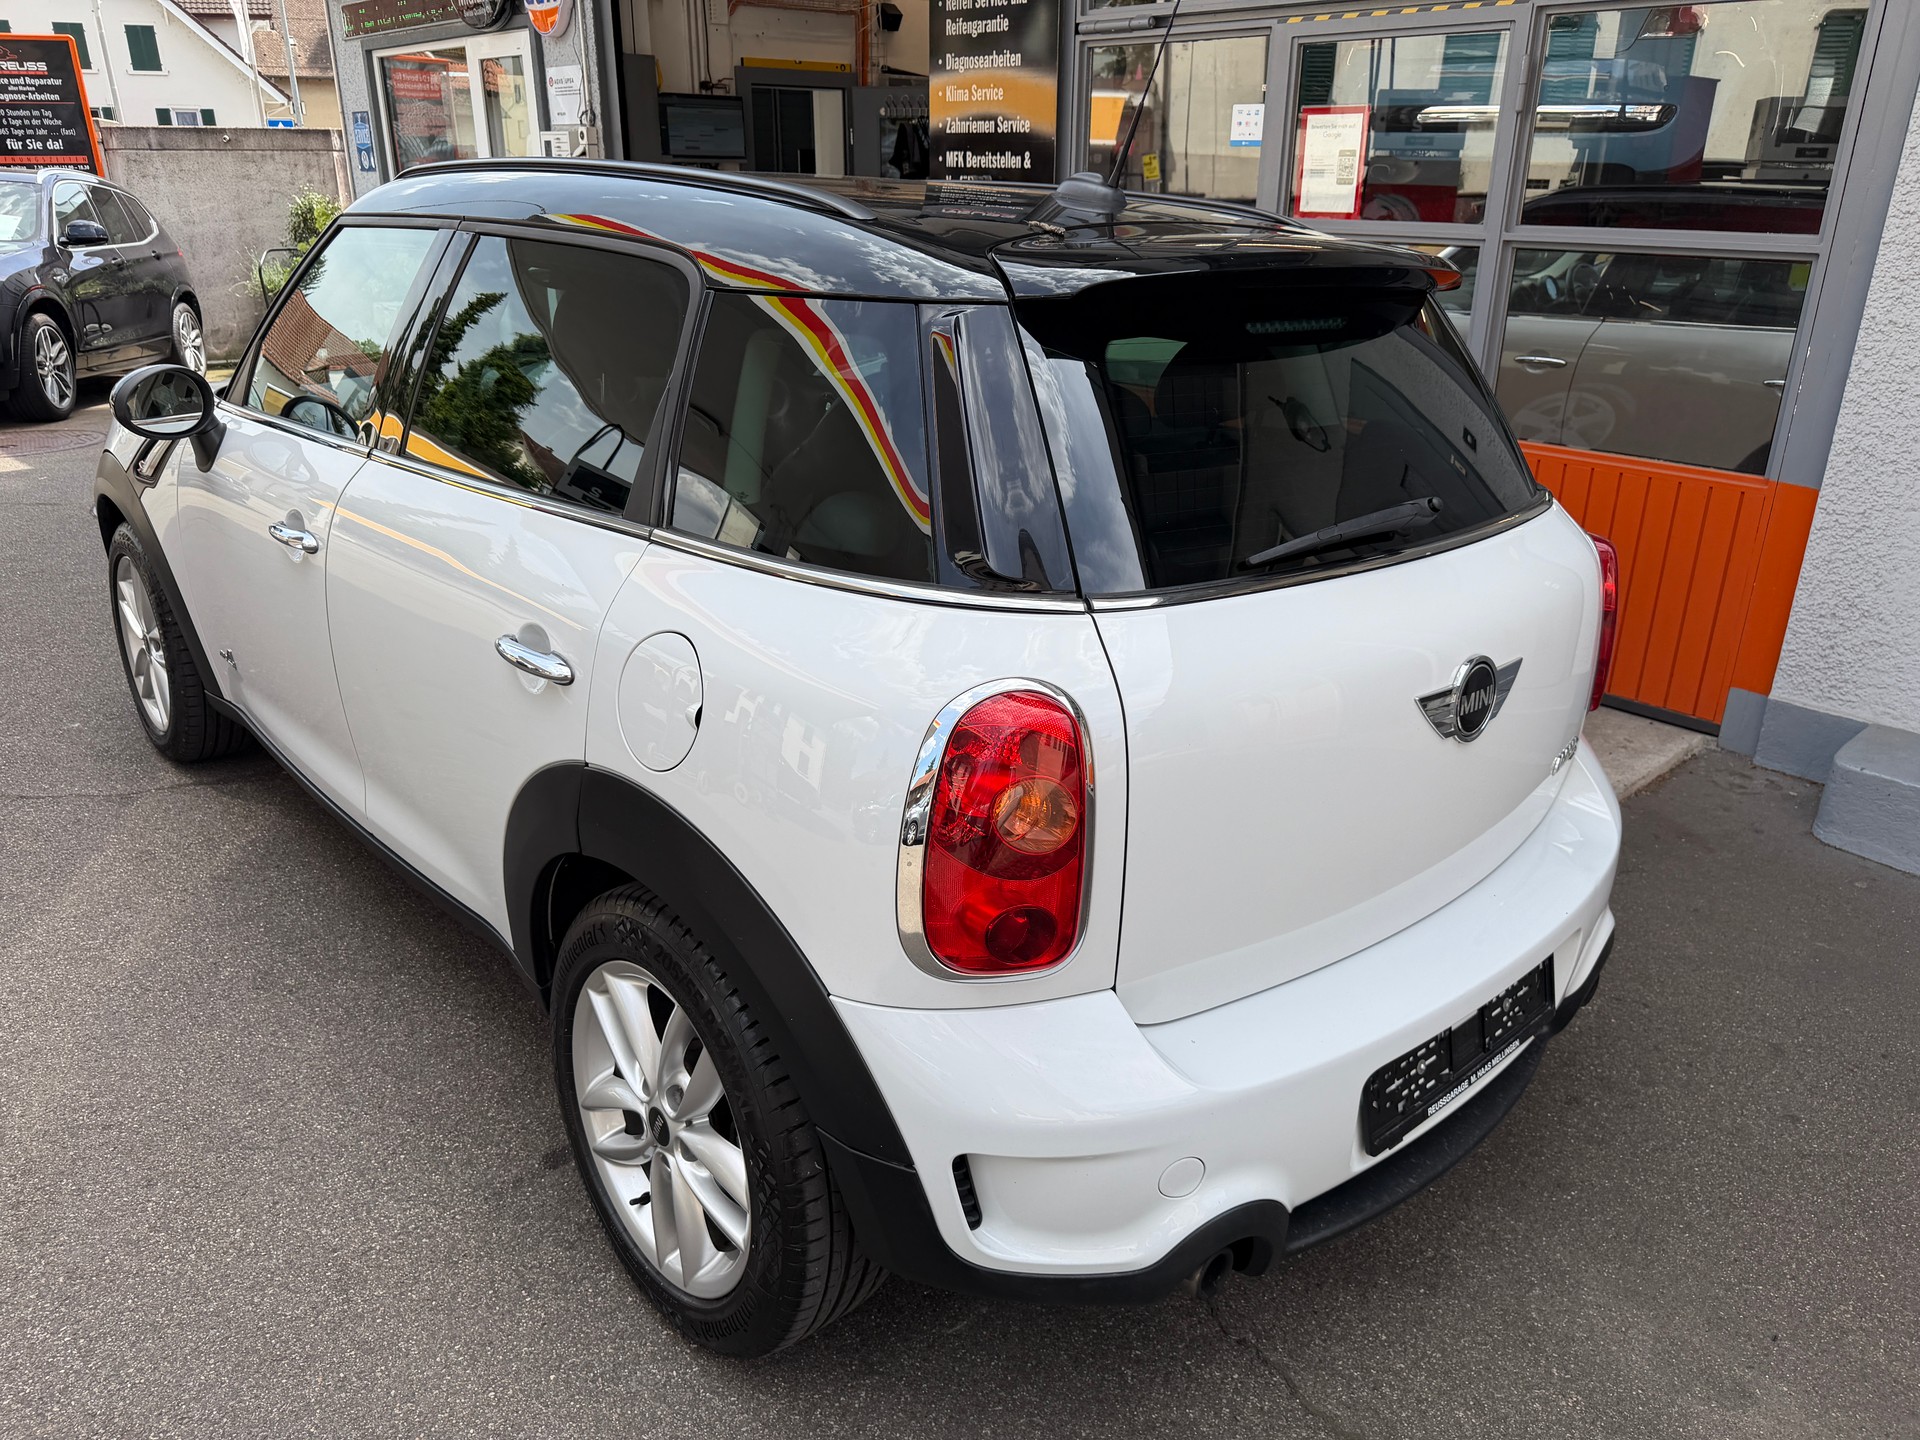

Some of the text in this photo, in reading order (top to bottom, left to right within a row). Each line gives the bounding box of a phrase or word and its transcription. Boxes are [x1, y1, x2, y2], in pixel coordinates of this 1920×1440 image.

[945, 14, 1009, 38] Reifengarantie
[0, 61, 48, 71] REUSS
[945, 50, 1022, 73] Diagnosearbeiten
[9, 77, 25, 85] und
[26, 77, 62, 86] Reparatur
[946, 84, 1004, 102] Klima Service
[6, 108, 31, 117] Stunden
[31, 109, 40, 117] im
[41, 109, 53, 118] Tag
[2, 118, 62, 127] 6 Tage in der Woche
[945, 115, 1031, 134] Zahnriemen Service
[11, 128, 25, 137] Tage
[26, 128, 35, 136] im
[35, 128, 48, 136] Jahr
[60, 128, 76, 136] (fast)
[6, 138, 64, 150] für Sie da!
[945, 151, 1032, 169] MFK Bereitstellen &
[1459, 684, 1493, 717] MINI
[1427, 1079, 1469, 1117] REUSSGARAGE
[1476, 1064, 1492, 1079] HAAS
[1491, 1038, 1520, 1067] MELLINGEN
